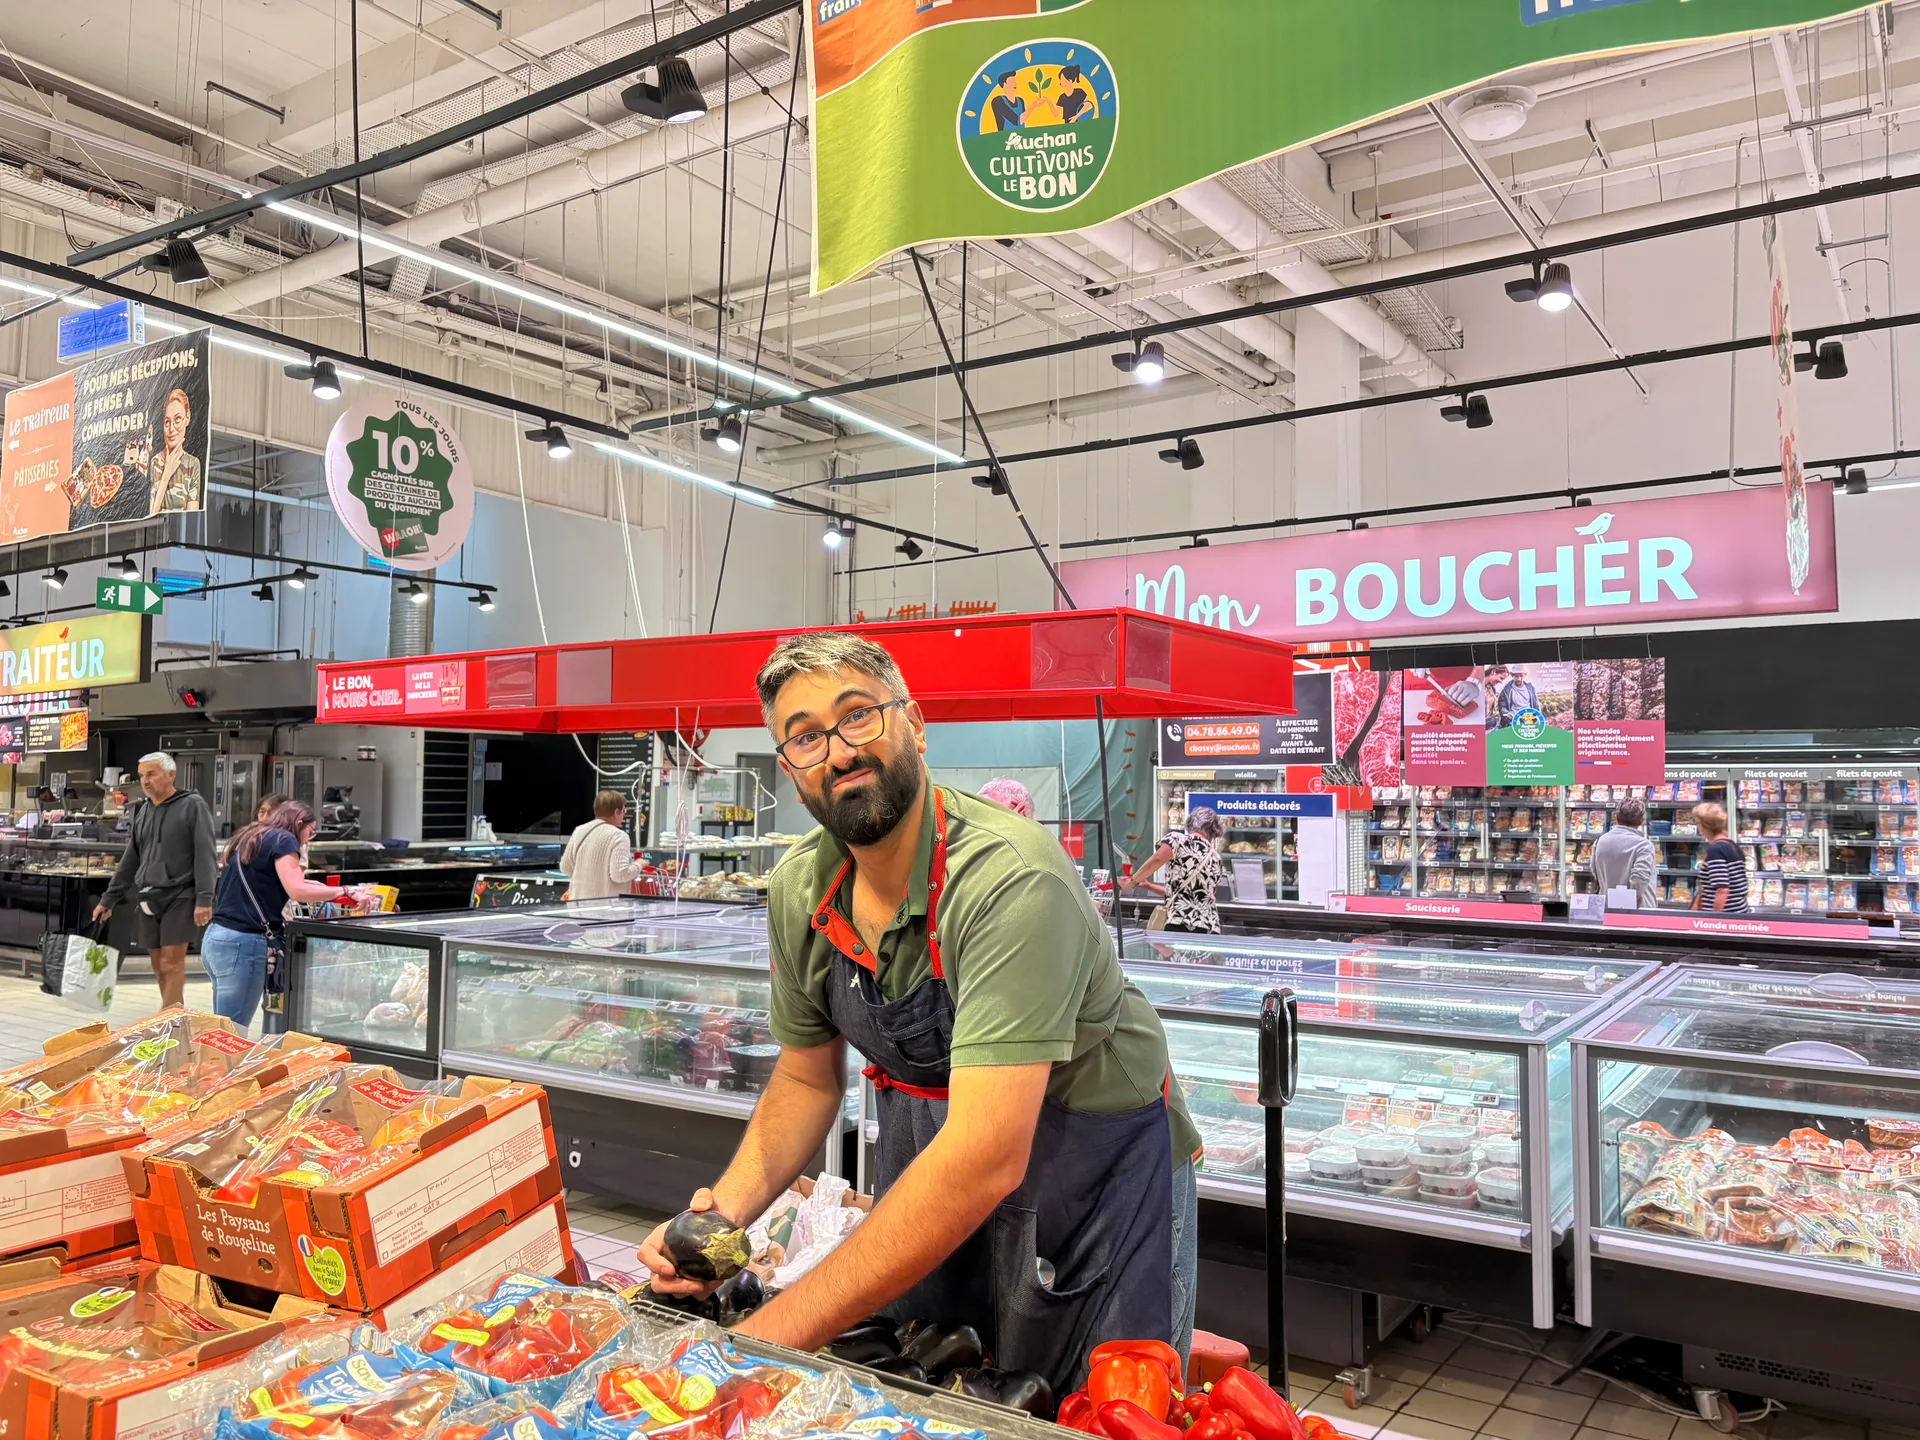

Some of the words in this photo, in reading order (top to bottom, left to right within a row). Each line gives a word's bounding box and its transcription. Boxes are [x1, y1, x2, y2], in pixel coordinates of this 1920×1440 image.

[1005, 132, 1076, 151] Auchan
[1004, 180, 1017, 192] LE
[1020, 171, 1077, 200] BON
[83, 374, 108, 396] POUR
[110, 367, 130, 387] MES
[132, 348, 198, 381] RÉCEPTIONS,
[83, 400, 92, 420] JE
[94, 392, 123, 414] PENSE
[124, 388, 134, 407] À
[395, 400, 422, 415] TOUS
[423, 412, 440, 428] LES
[439, 428, 460, 463] JOURS
[14, 459, 59, 488] PÂTISSERIES
[371, 471, 417, 485] CAGNOTTÉS
[419, 479, 434, 488] SUR
[367, 480, 383, 488] DES
[384, 483, 427, 496] CENTAINES
[375, 501, 386, 509] DU
[408, 497, 439, 508] AUCHAN
[1136, 565, 1261, 630] Mon
[1296, 536, 1698, 627] BOUCHER
[333, 677, 345, 691] LE
[348, 675, 373, 691] BON,
[332, 691, 368, 709] MOINS
[1187, 726, 1259, 737] 04.78.86.49.04
[1595, 734, 1655, 743] majoritairement
[1189, 743, 1260, 753] cbossy@auchan.fr
[1297, 746, 1325, 754] RETRAIT
[1578, 749, 1603, 757] origine
[1691, 770, 1717, 779] poulet
[1745, 770, 1764, 778] filets
[1765, 770, 1778, 778] de
[1780, 770, 1808, 779] poulet
[1836, 770, 1860, 778] filets
[1861, 770, 1872, 778] de
[1873, 770, 1903, 779] poulet
[1217, 800, 1258, 810] Produits
[1259, 800, 1301, 811] élaborés
[1405, 903, 1460, 914] Saucisserie
[1692, 920, 1727, 931] Viande
[1728, 922, 1769, 932] marinée
[397, 1202, 418, 1218] FRANCE
[423, 1203, 435, 1213] CAT
[196, 1204, 217, 1223] Les
[220, 1208, 271, 1234] Paysans
[202, 1225, 214, 1241] de
[216, 1228, 276, 1255] Rougeline
